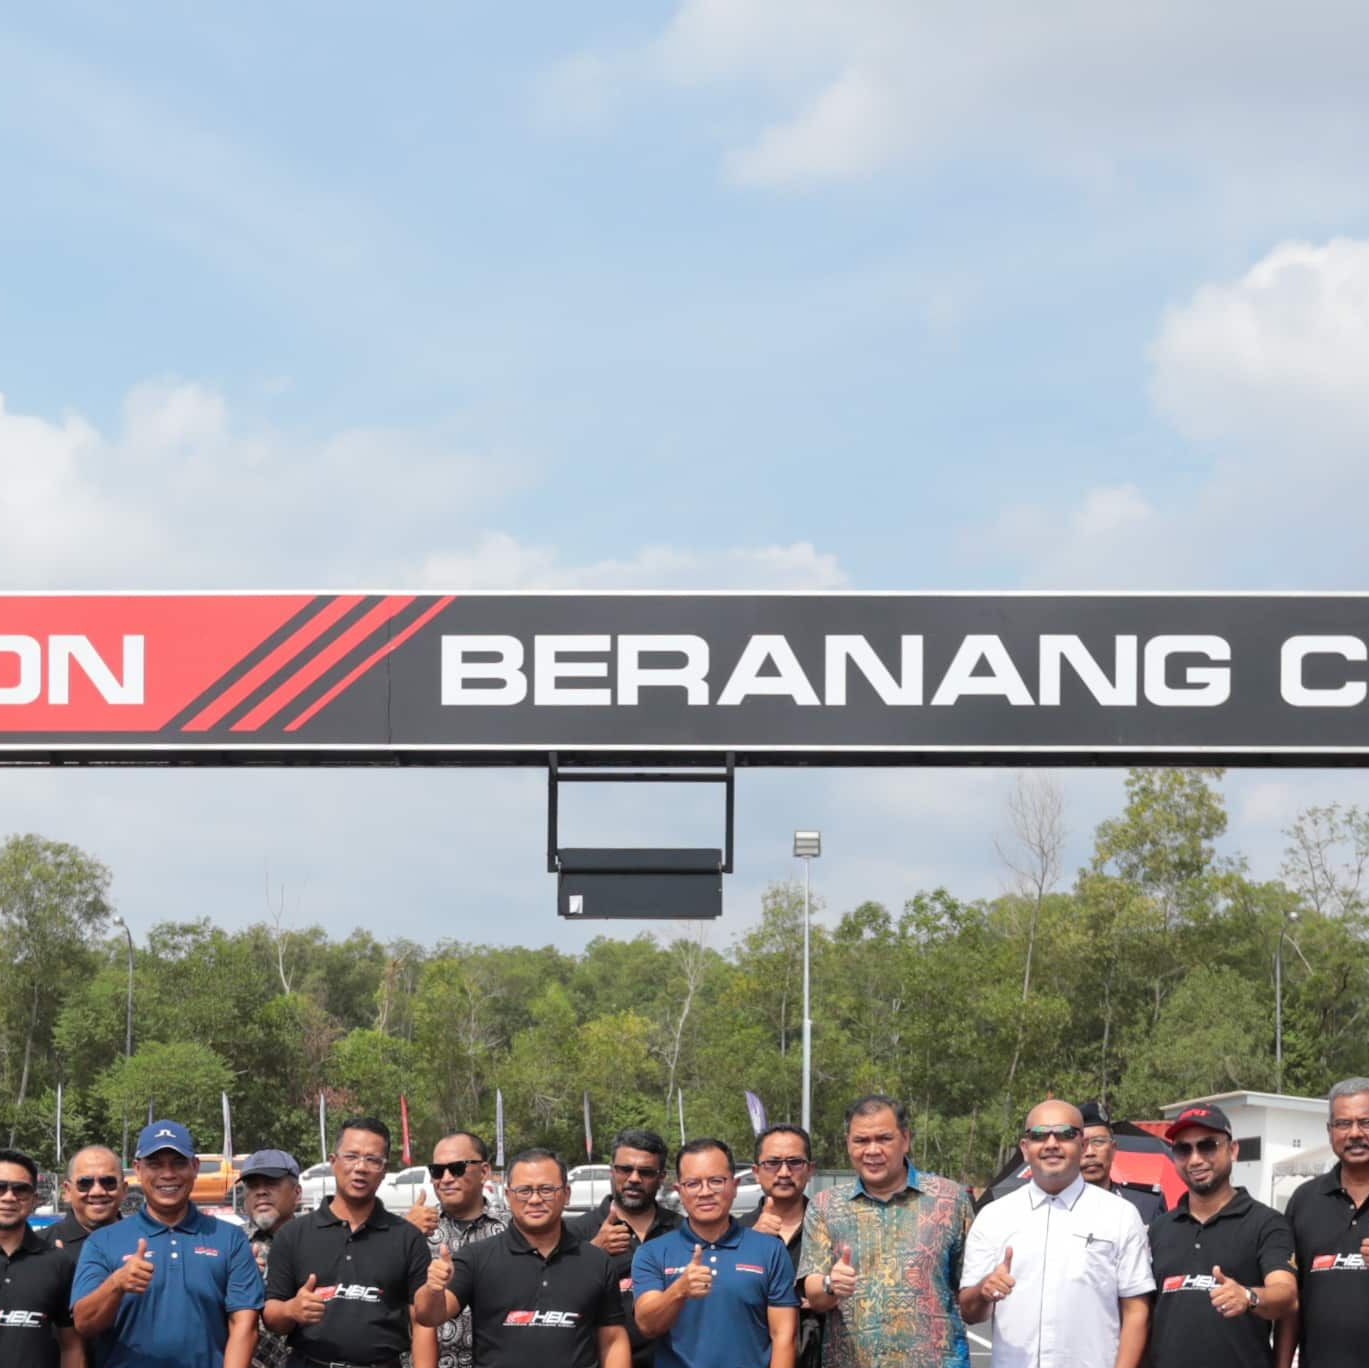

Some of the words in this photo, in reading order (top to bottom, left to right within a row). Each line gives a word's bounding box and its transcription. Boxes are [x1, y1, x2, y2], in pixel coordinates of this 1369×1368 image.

[441, 634, 1231, 706] BERANANG
[334, 1283, 380, 1299] HBC
[532, 1310, 580, 1324] HBC
